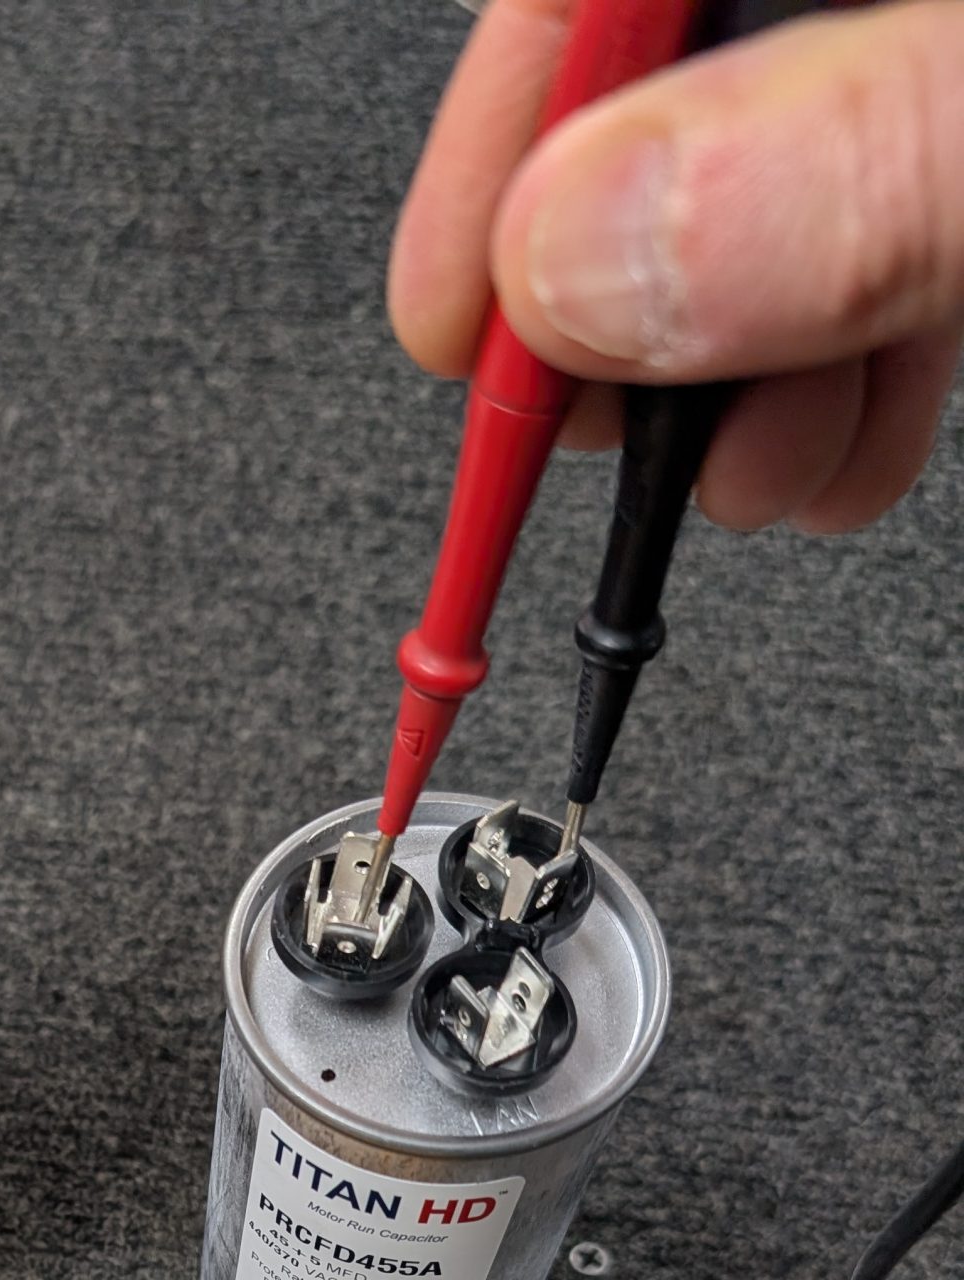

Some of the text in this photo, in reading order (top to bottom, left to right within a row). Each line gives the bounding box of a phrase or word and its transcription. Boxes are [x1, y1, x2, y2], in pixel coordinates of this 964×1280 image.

[270, 1130, 497, 1225] TITAN HD
[249, 1220, 299, 1268] 440/370
[260, 1192, 442, 1276] PRCFD455A
[307, 1201, 449, 1243] Motor Run Capacitor
[270, 1229, 289, 1247] 45
[310, 1255, 321, 1266] 5
